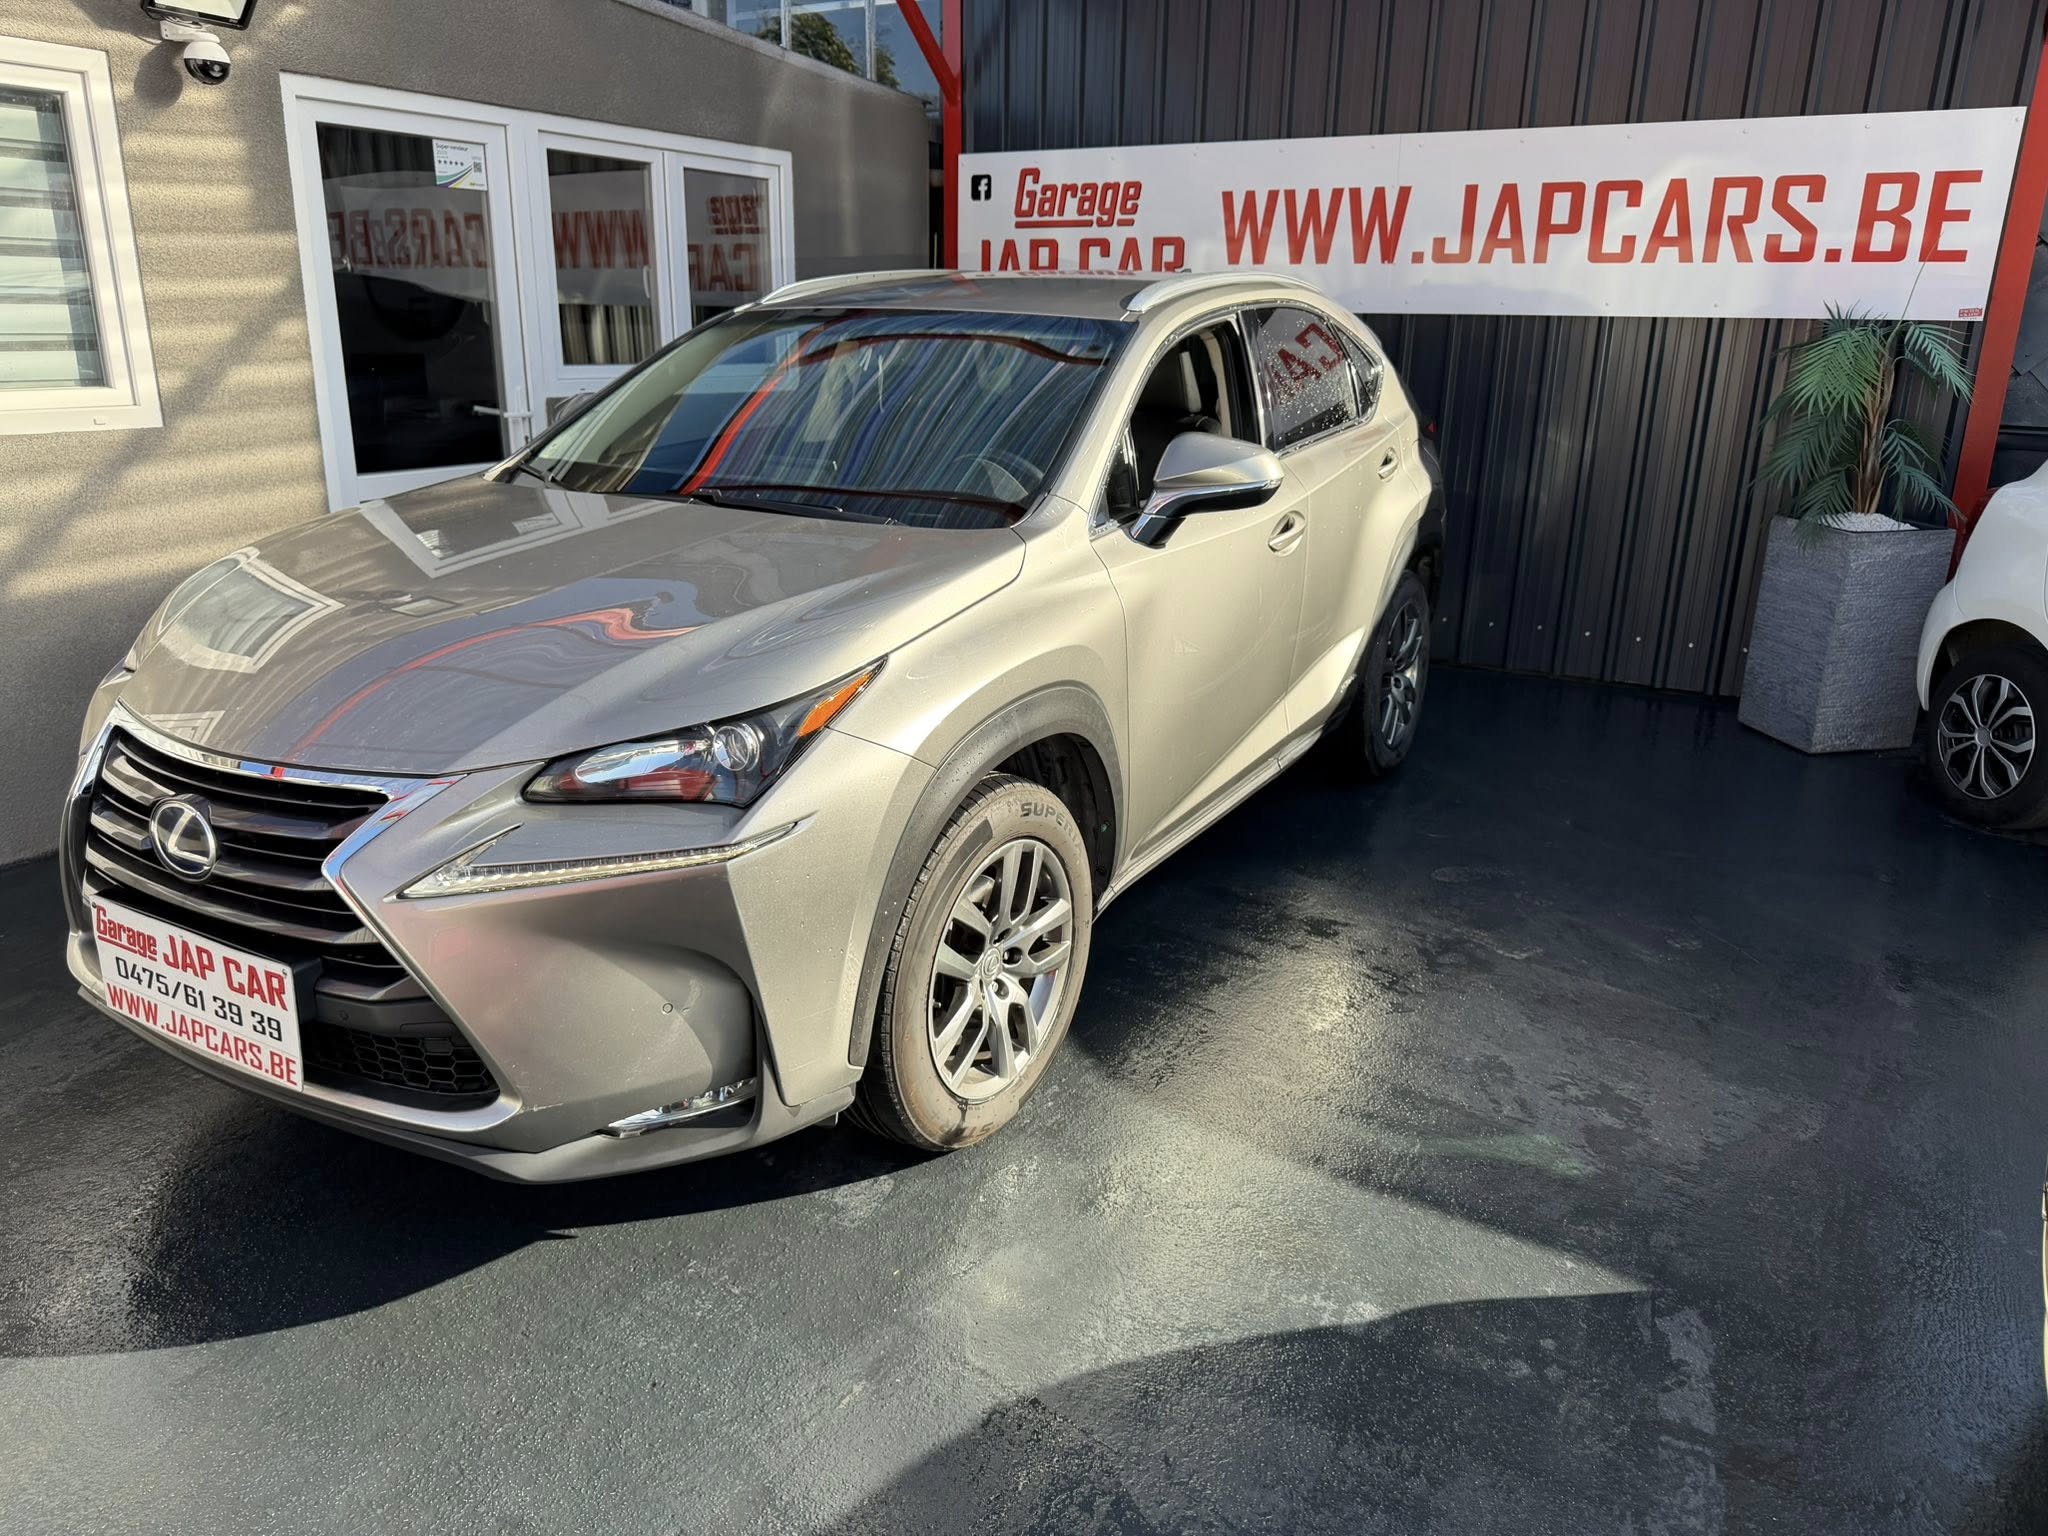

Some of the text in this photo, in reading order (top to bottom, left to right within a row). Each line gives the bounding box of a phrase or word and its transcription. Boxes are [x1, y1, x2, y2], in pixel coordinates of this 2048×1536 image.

[1014, 167, 1143, 228] Garage
[1221, 169, 1984, 265] WWW.JAPCARS.BE
[96, 904, 288, 1011] Garage JAP CAR
[115, 956, 282, 1042] 0475/61 39 39
[107, 982, 297, 1086] WWW.JAPCARS.BE
